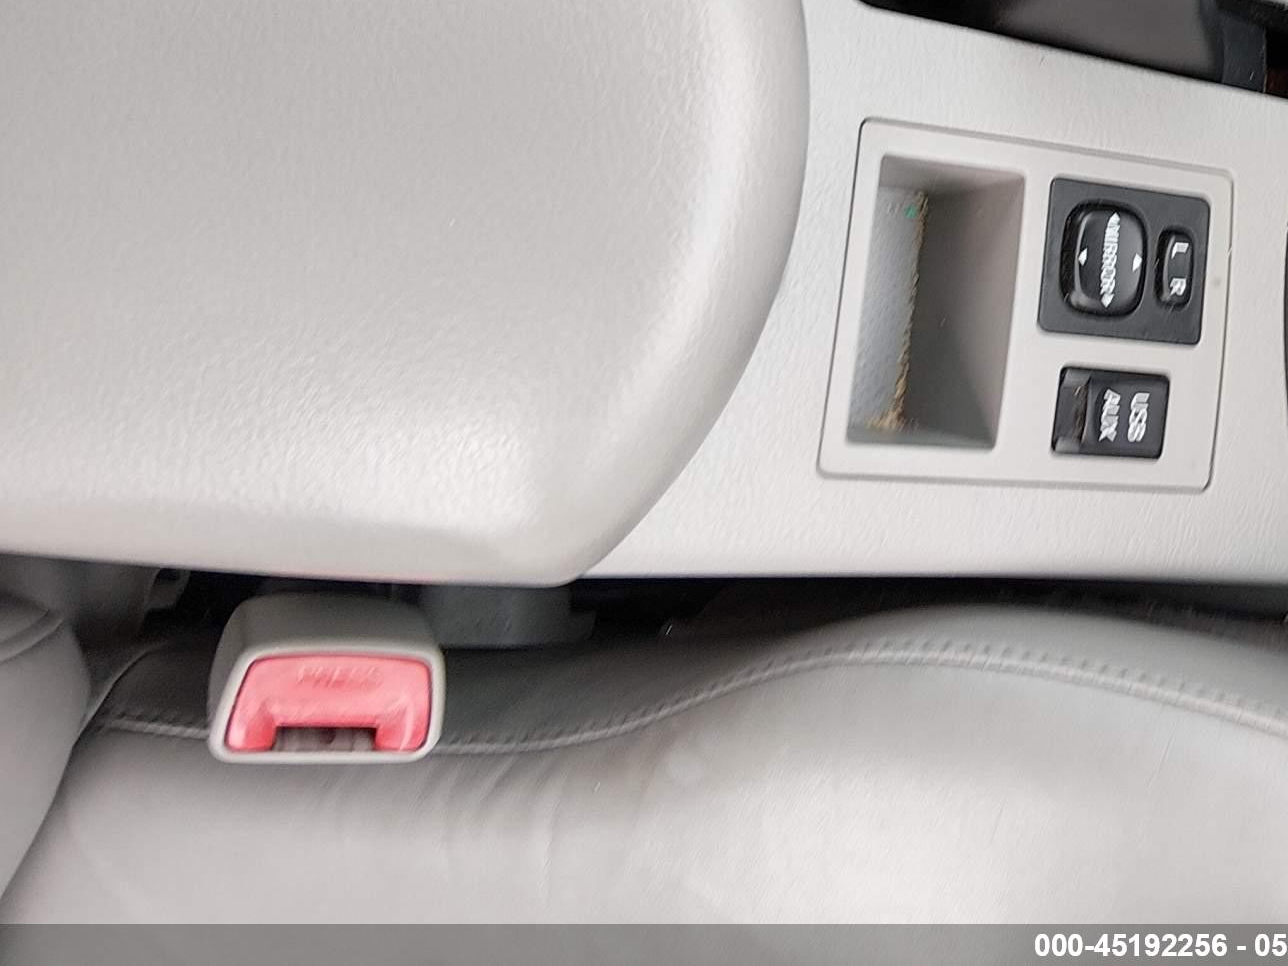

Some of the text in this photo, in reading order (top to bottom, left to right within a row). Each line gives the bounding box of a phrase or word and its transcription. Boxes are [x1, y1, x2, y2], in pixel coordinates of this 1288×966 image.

[1100, 221, 1120, 295] MIRROR
[1168, 242, 1190, 299] L R
[1099, 389, 1121, 442] AUX
